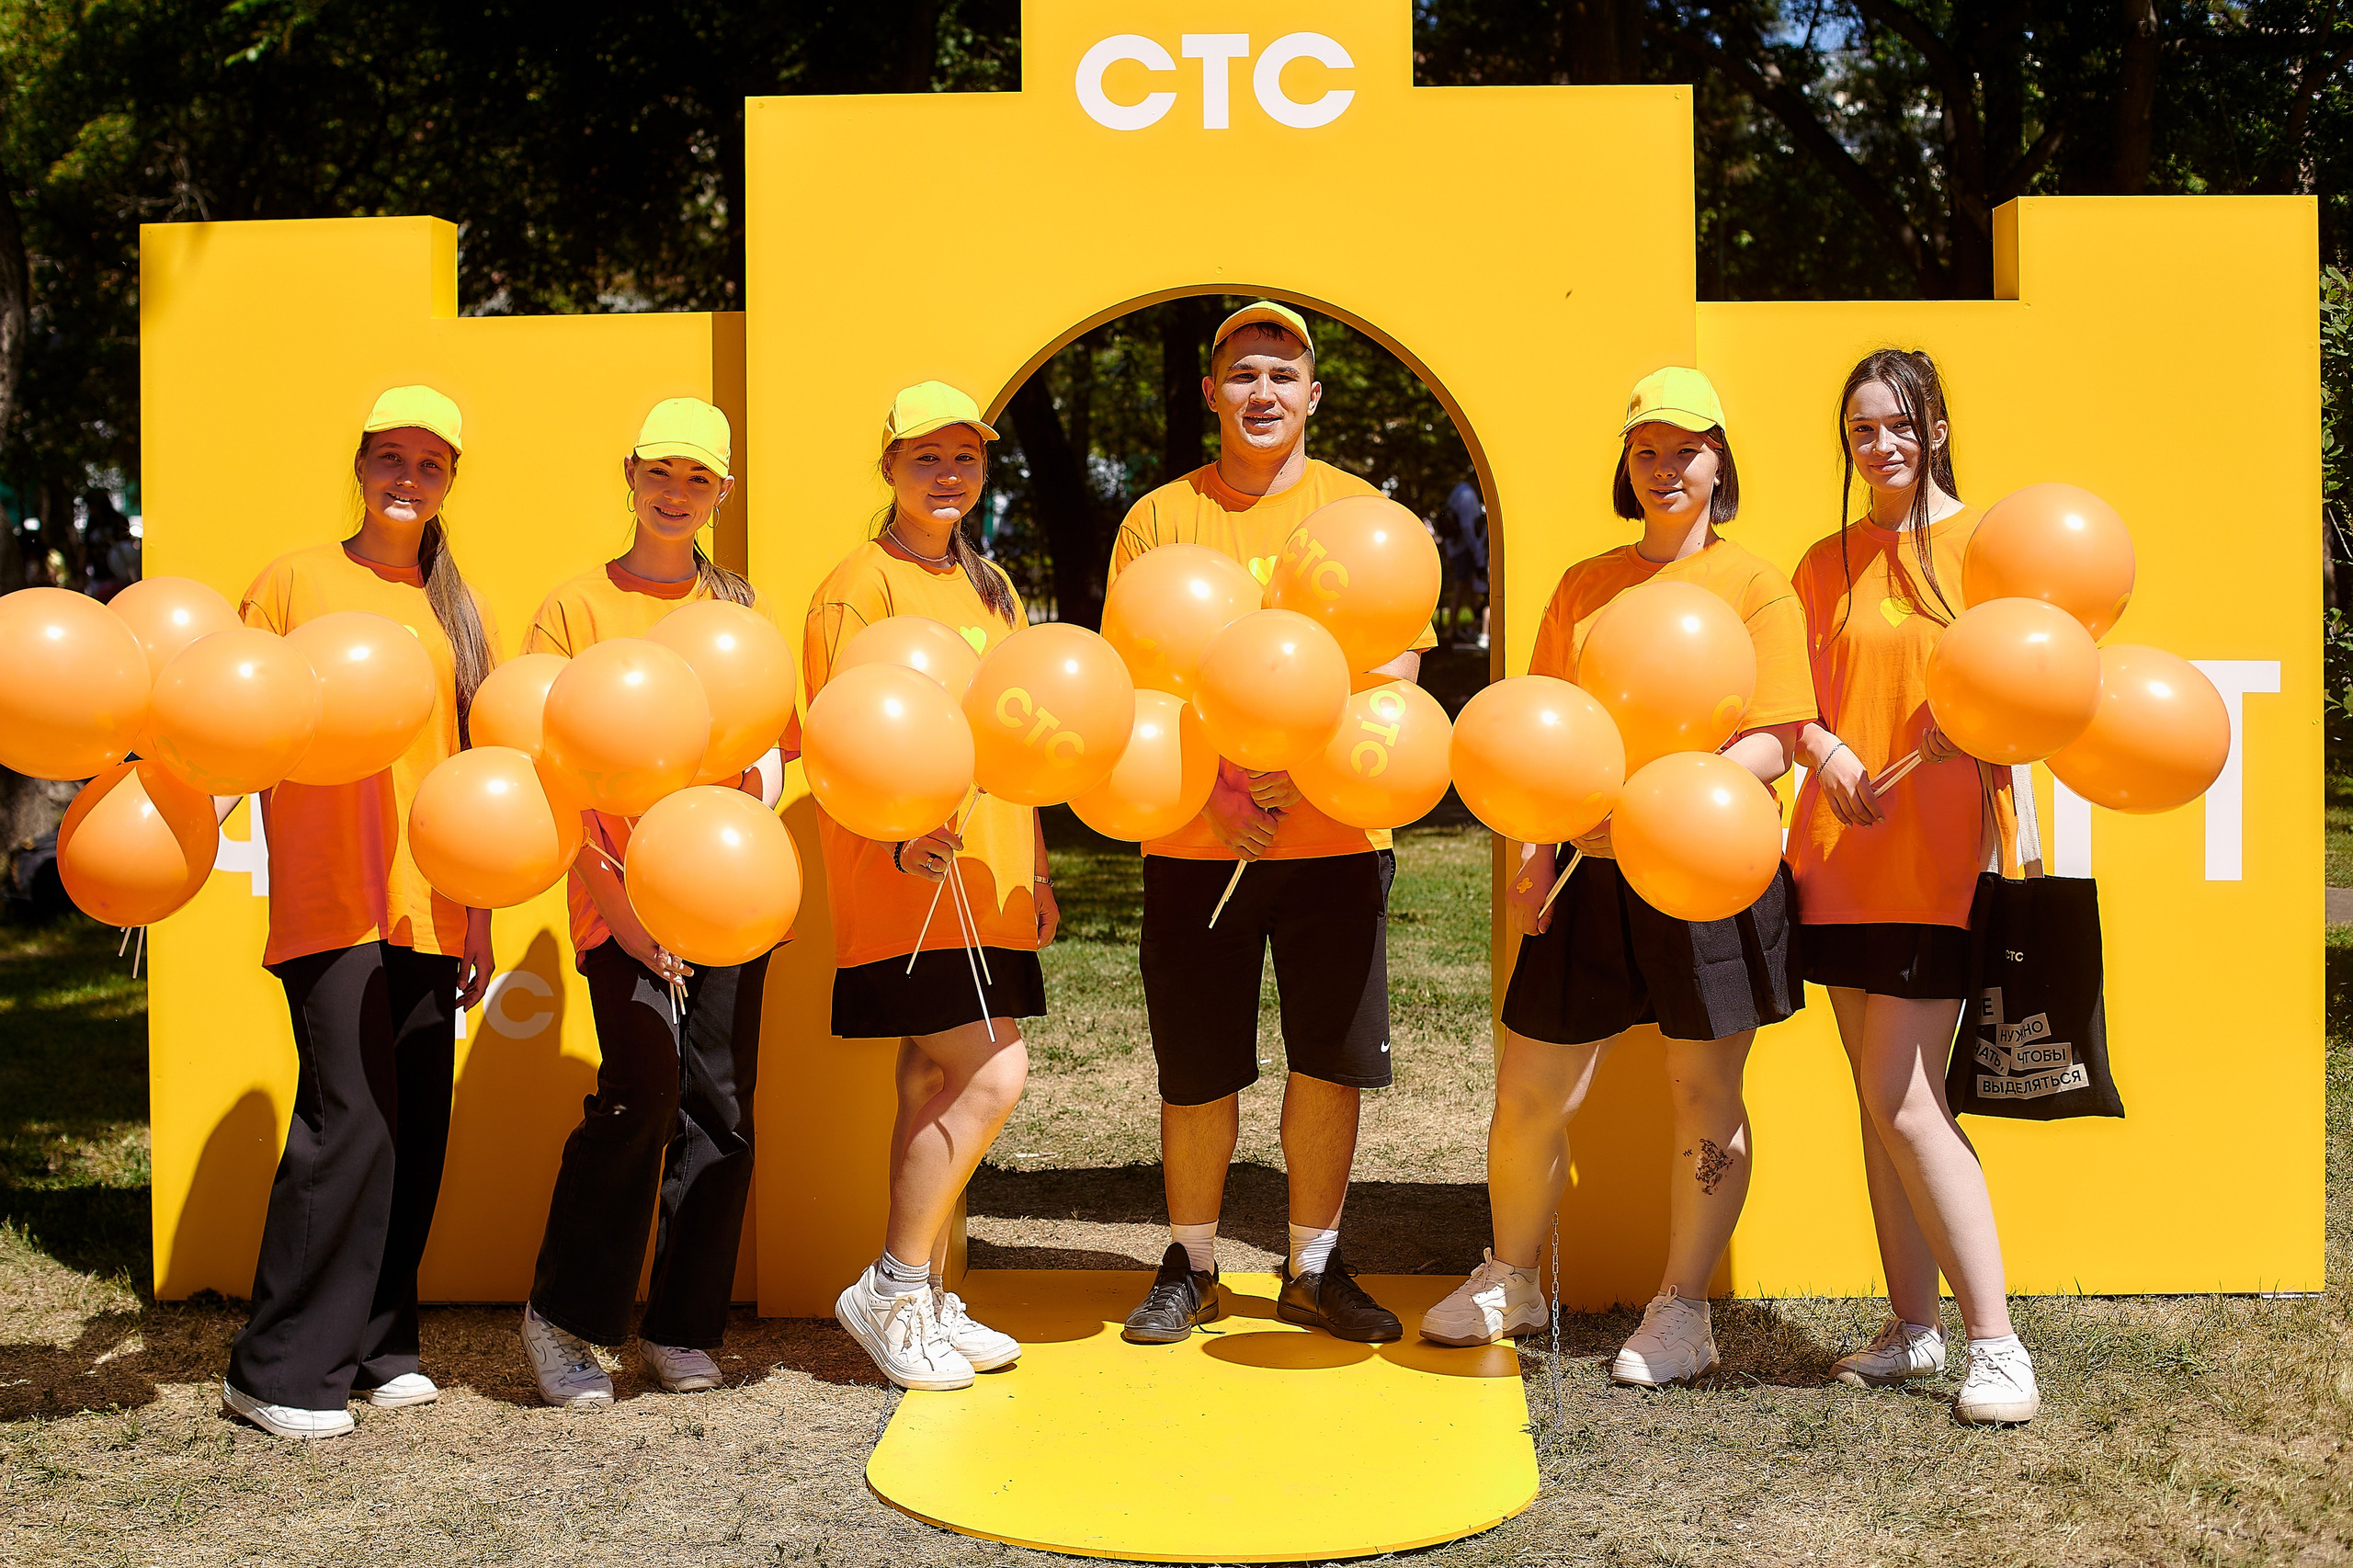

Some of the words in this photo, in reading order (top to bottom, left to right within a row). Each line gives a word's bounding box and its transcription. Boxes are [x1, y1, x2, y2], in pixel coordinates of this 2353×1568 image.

[1075, 32, 1356, 131] СТС
[1281, 527, 1349, 602] СТС
[995, 687, 1086, 769] СТС
[1350, 689, 1406, 778] СТС
[2005, 949, 2024, 962] СТС
[2000, 1020, 2043, 1042] НУЖНО
[2017, 1049, 2066, 1064] ЧТОБЫ
[1983, 1070, 2082, 1095] ВЫДЕЛЯТЬСЯ
